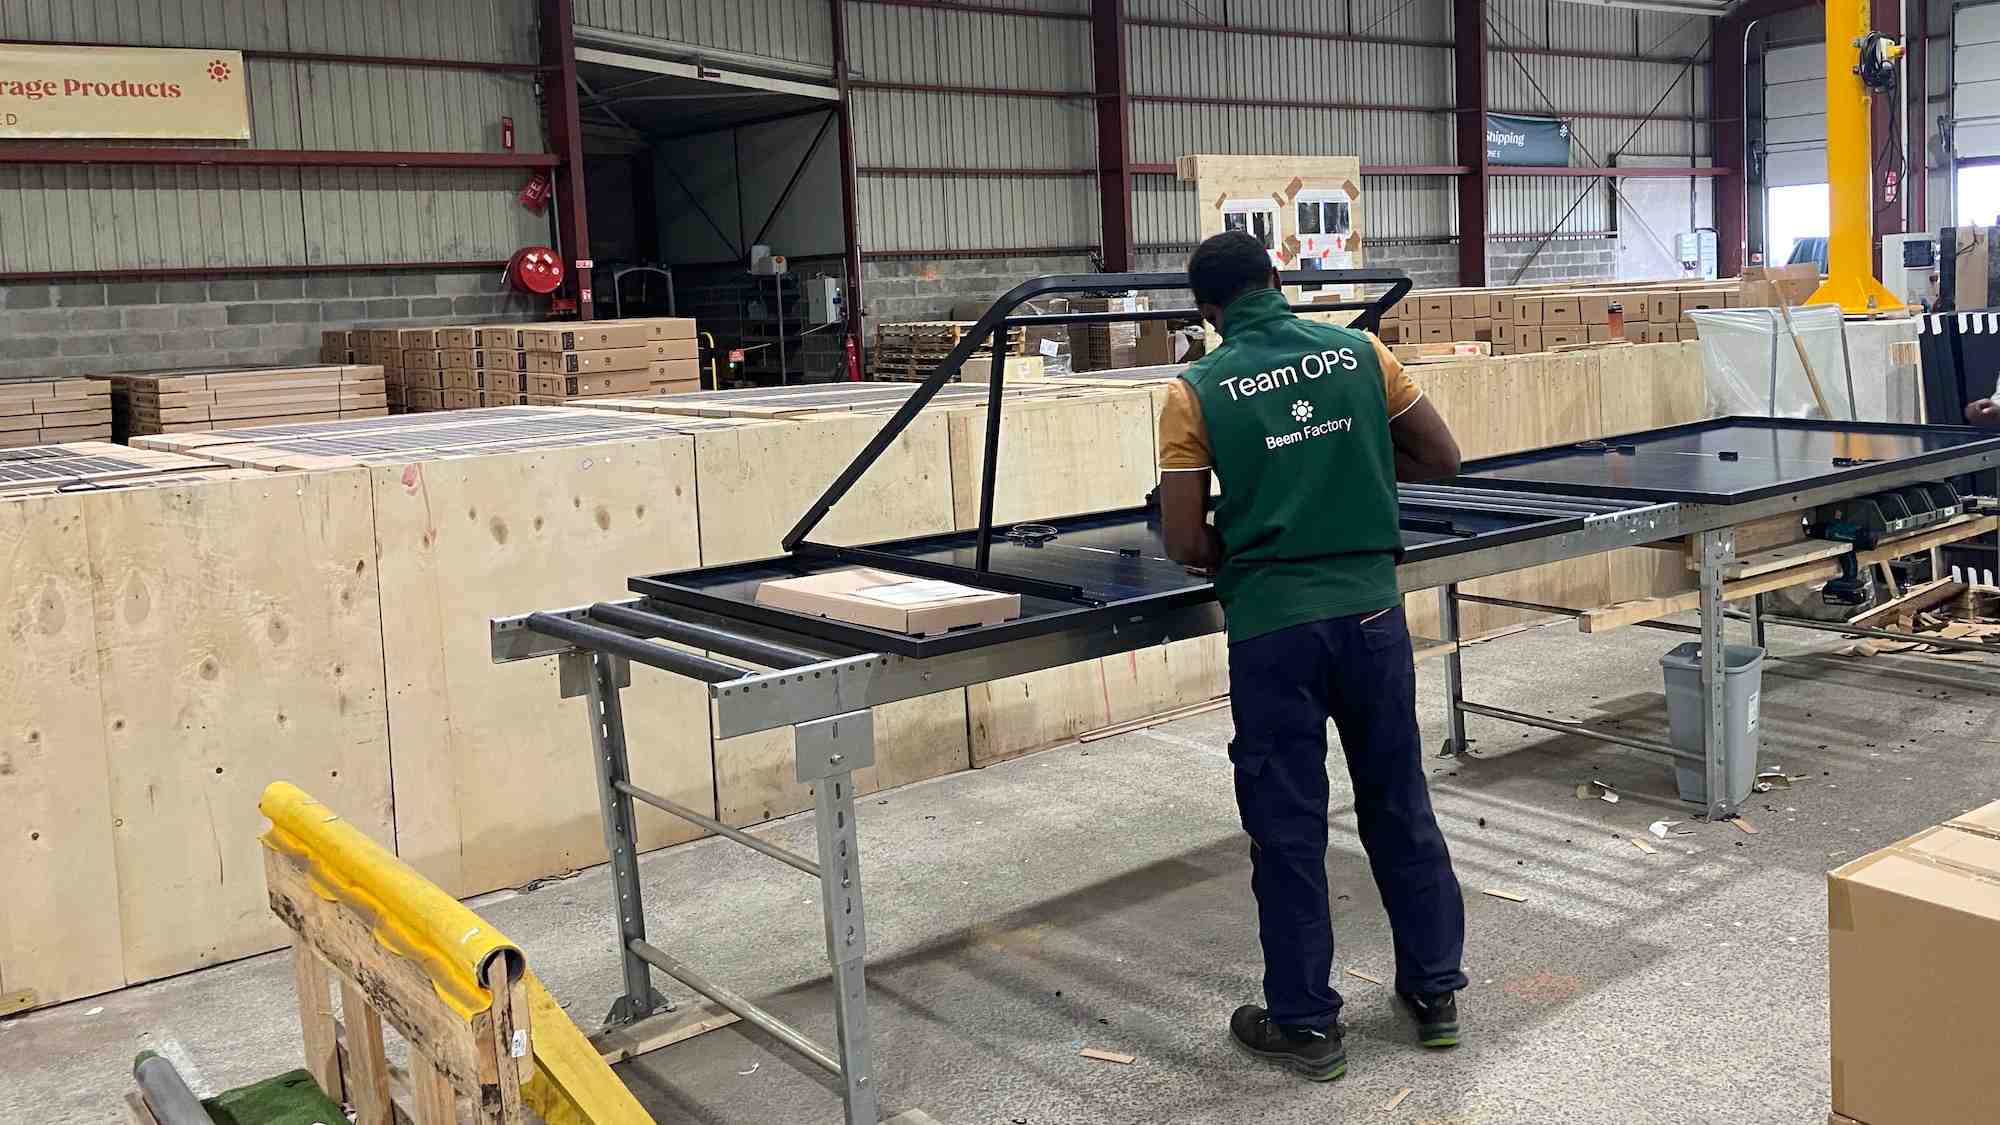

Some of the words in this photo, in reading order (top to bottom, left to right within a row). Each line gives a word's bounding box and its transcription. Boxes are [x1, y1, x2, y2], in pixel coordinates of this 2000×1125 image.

[63, 78, 182, 98] Products
[1219, 364, 1298, 401] Team
[1301, 347, 1358, 379] OPS
[1265, 431, 1302, 450] Beem
[1303, 417, 1352, 439] Factory
